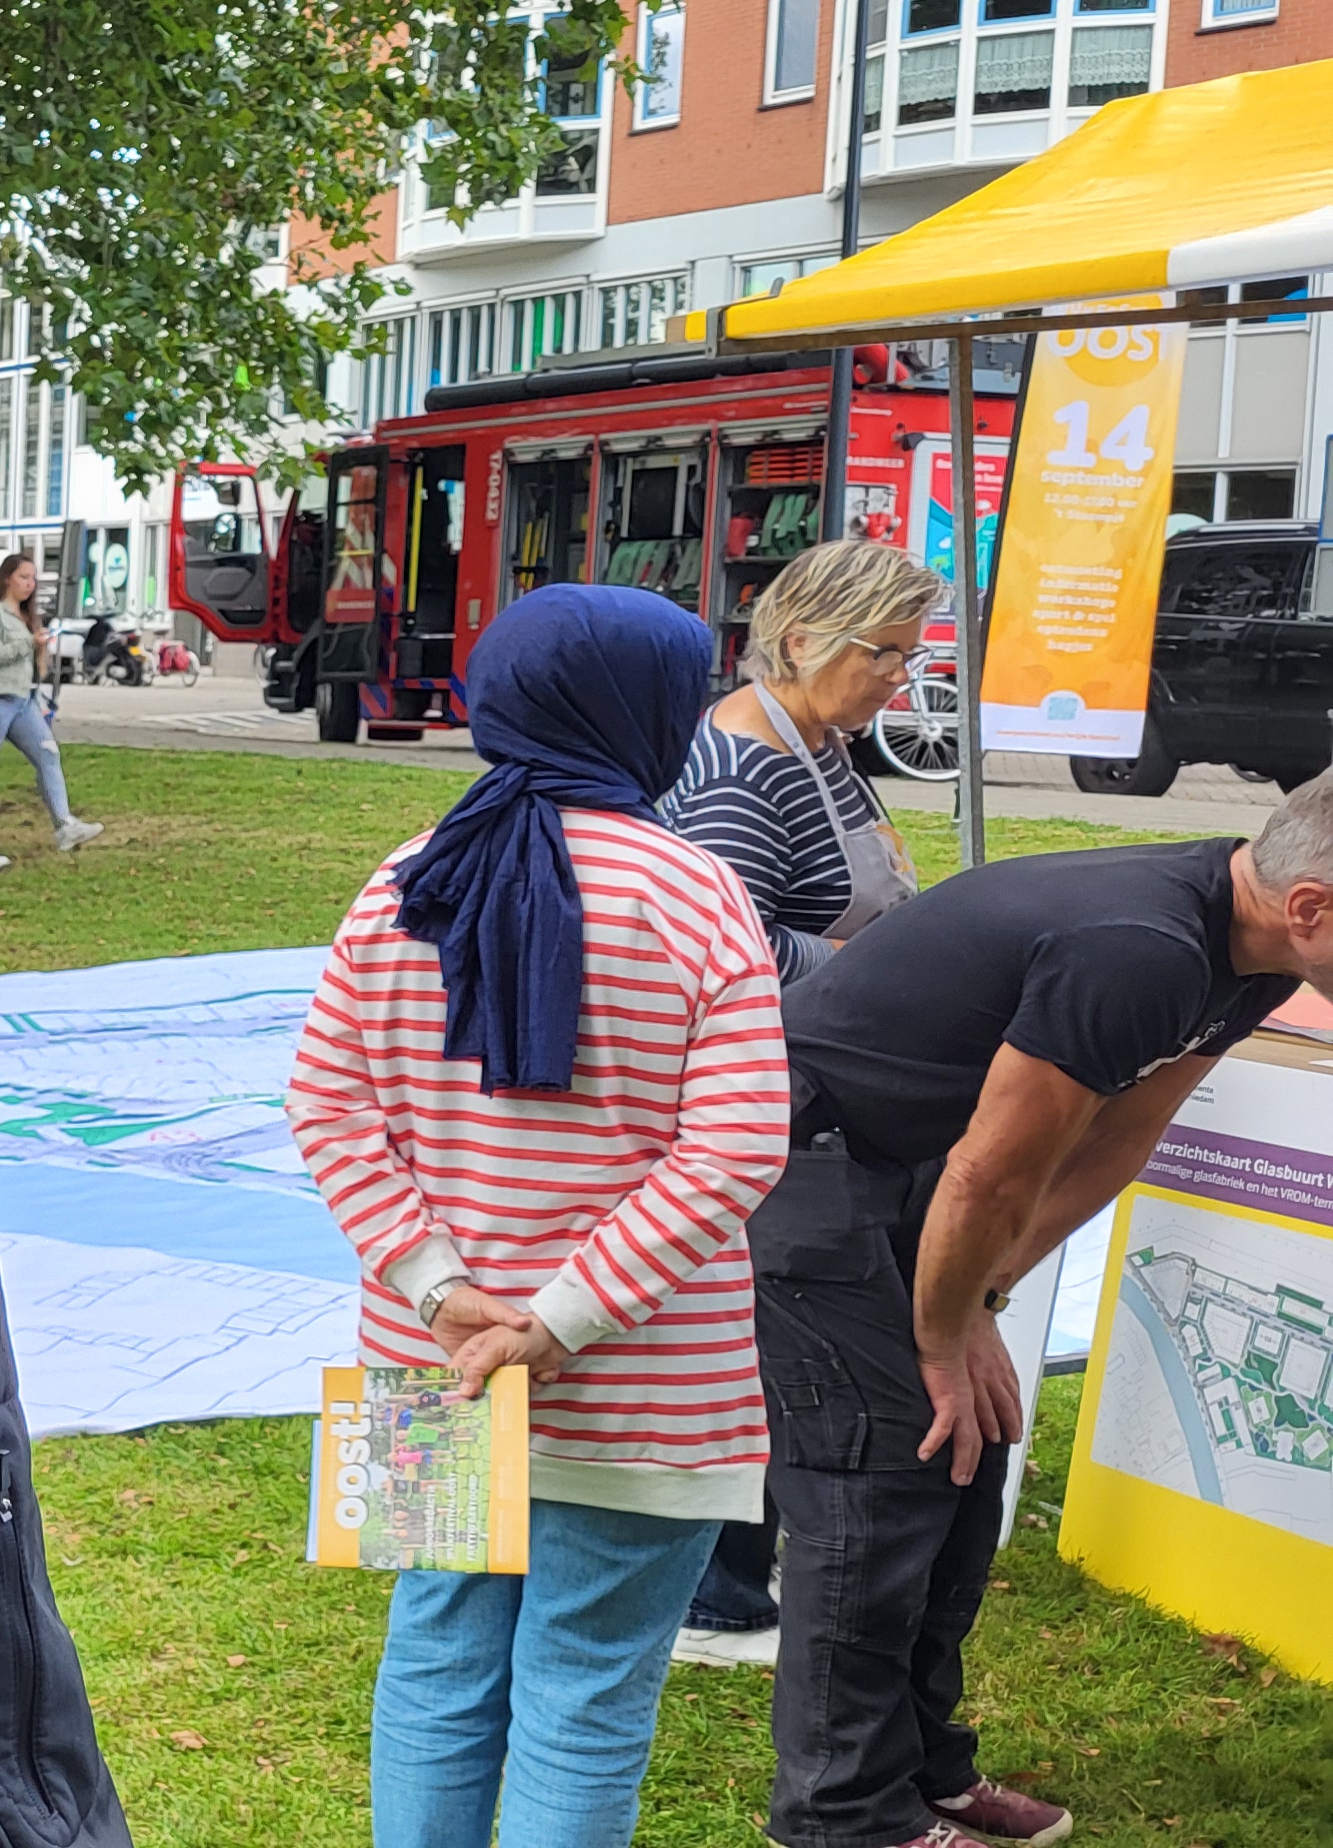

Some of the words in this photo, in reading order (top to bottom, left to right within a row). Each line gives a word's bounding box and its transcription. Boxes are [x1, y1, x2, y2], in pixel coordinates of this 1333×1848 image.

[1046, 400, 1154, 471] 14
[1145, 1160, 1193, 1180] oormalige
[1193, 1169, 1244, 1190] glasfabriek
[1246, 1180, 1260, 1193] en
[1261, 1183, 1278, 1198] het
[1156, 1141, 1251, 1172] verzichtskaart
[1253, 1158, 1324, 1188] Glasbuurt
[329, 1401, 373, 1530] oost!
